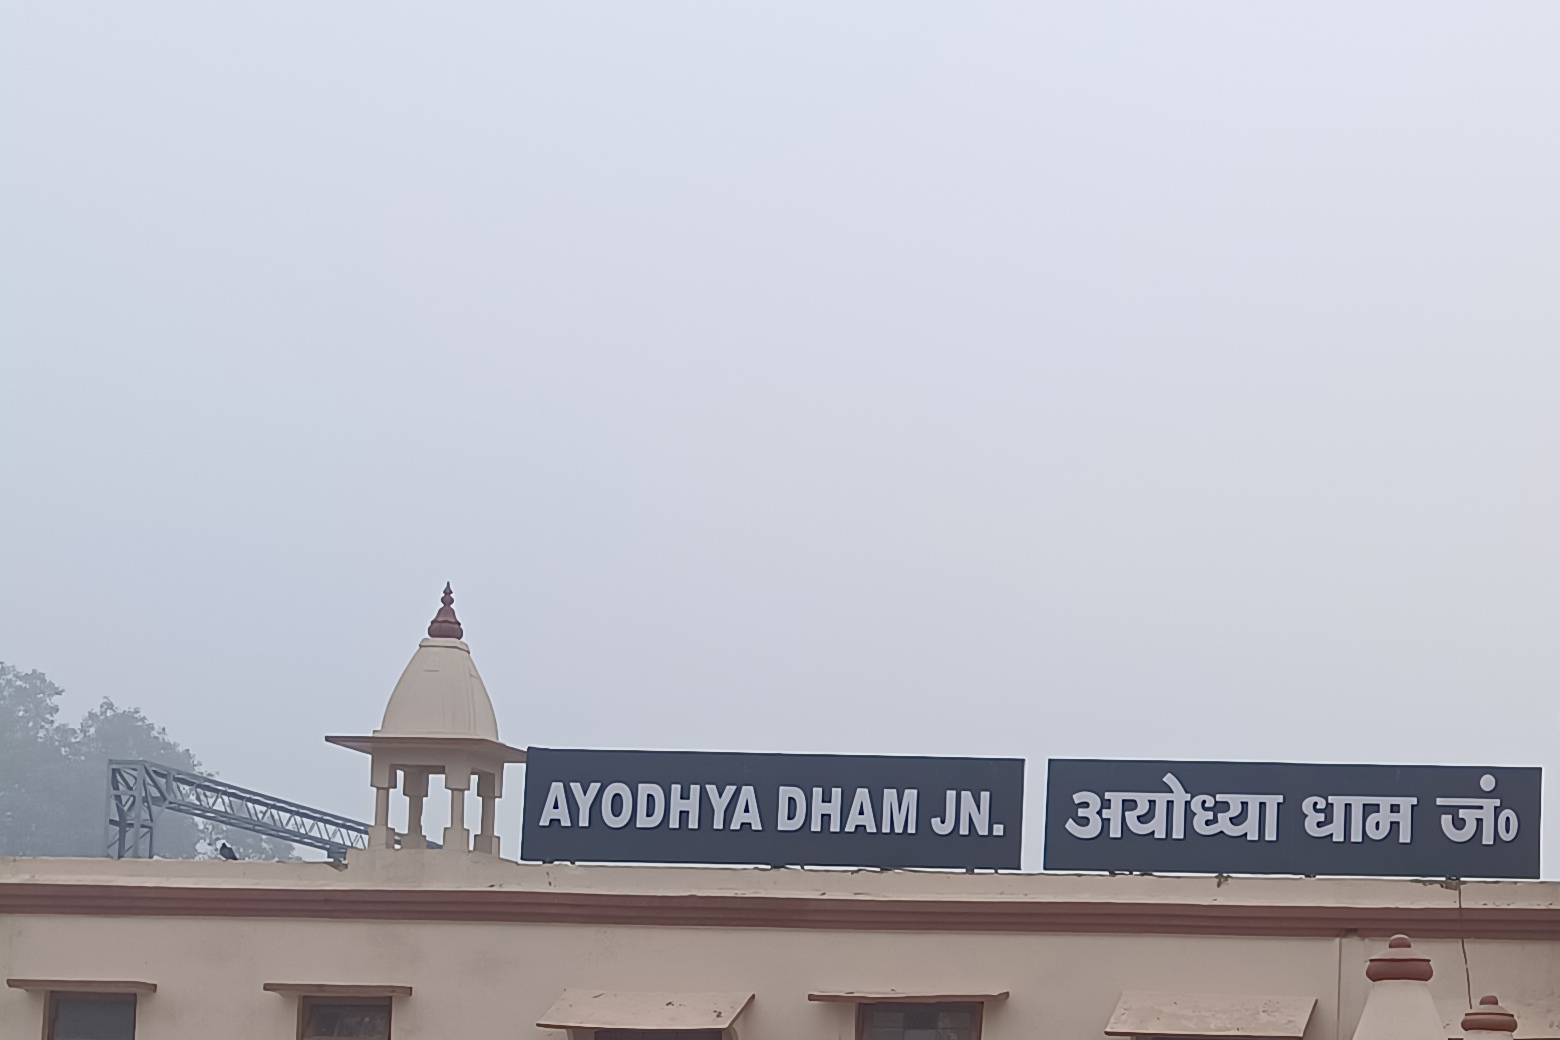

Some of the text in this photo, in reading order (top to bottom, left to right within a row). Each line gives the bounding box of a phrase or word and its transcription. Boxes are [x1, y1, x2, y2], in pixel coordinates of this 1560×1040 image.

[538, 781, 1004, 836] AYODHYA DHAM JN.
[1064, 772, 1284, 842] अयोध्या
[1301, 795, 1418, 844] धाम
